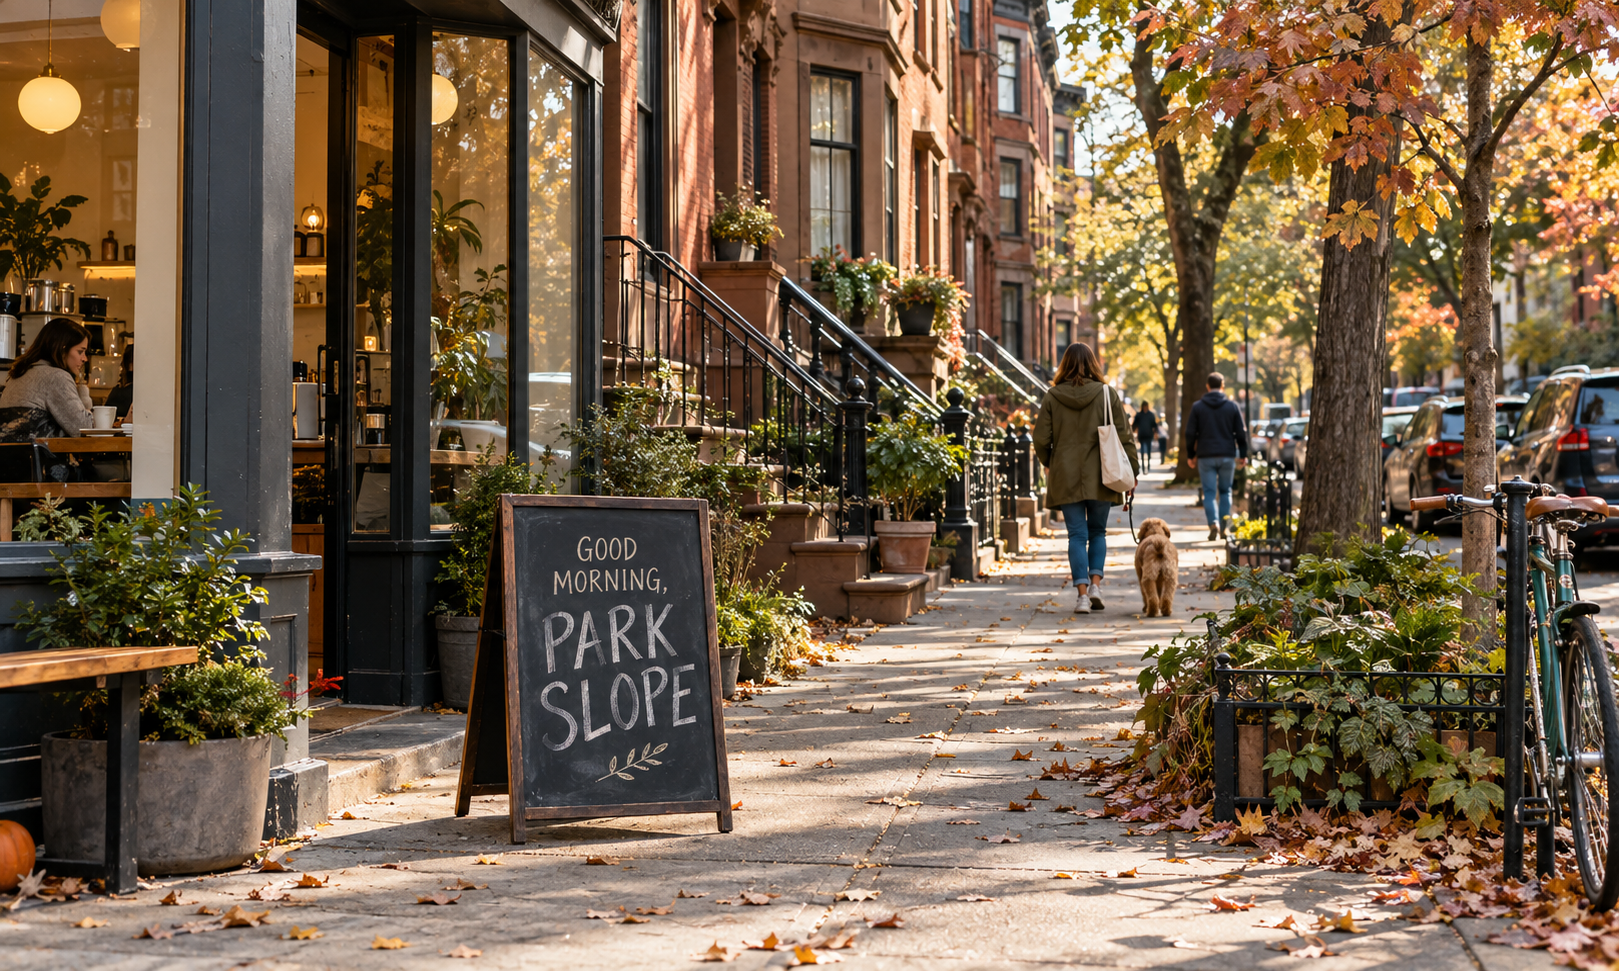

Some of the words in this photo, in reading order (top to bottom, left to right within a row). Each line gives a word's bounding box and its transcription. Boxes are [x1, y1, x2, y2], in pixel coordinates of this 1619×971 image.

[577, 536, 637, 562] GOOD
[554, 567, 668, 595] MORNING,
[542, 603, 678, 673] PARK
[540, 663, 696, 751] SLOPE
